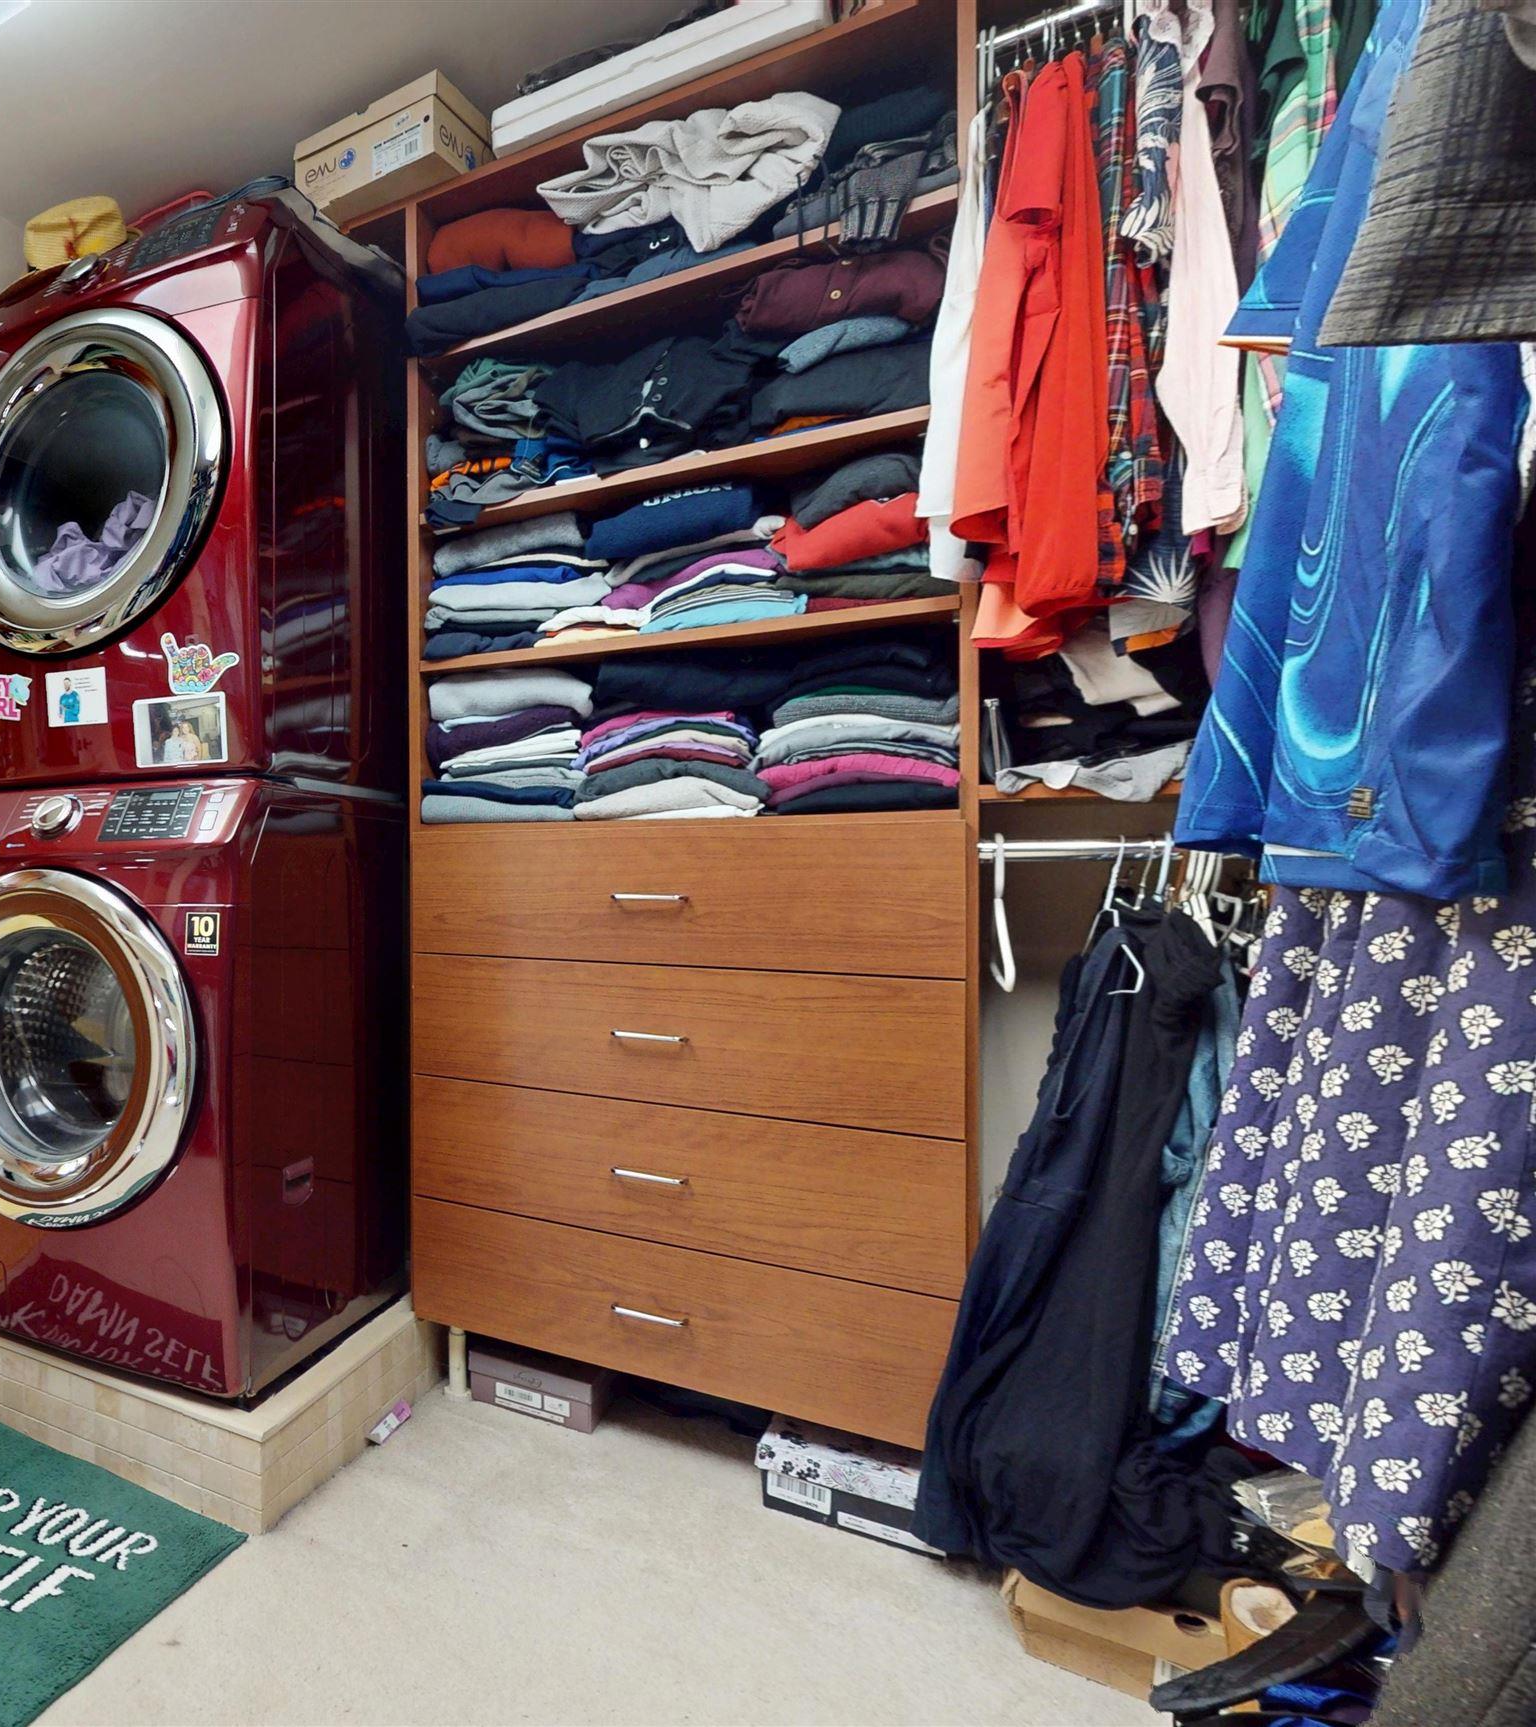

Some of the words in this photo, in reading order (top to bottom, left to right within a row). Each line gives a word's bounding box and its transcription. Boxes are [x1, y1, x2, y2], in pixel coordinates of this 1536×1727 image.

[191, 915, 214, 937] 10
[194, 936, 211, 944] YEAR
[9, 1497, 159, 1571] YOUR
